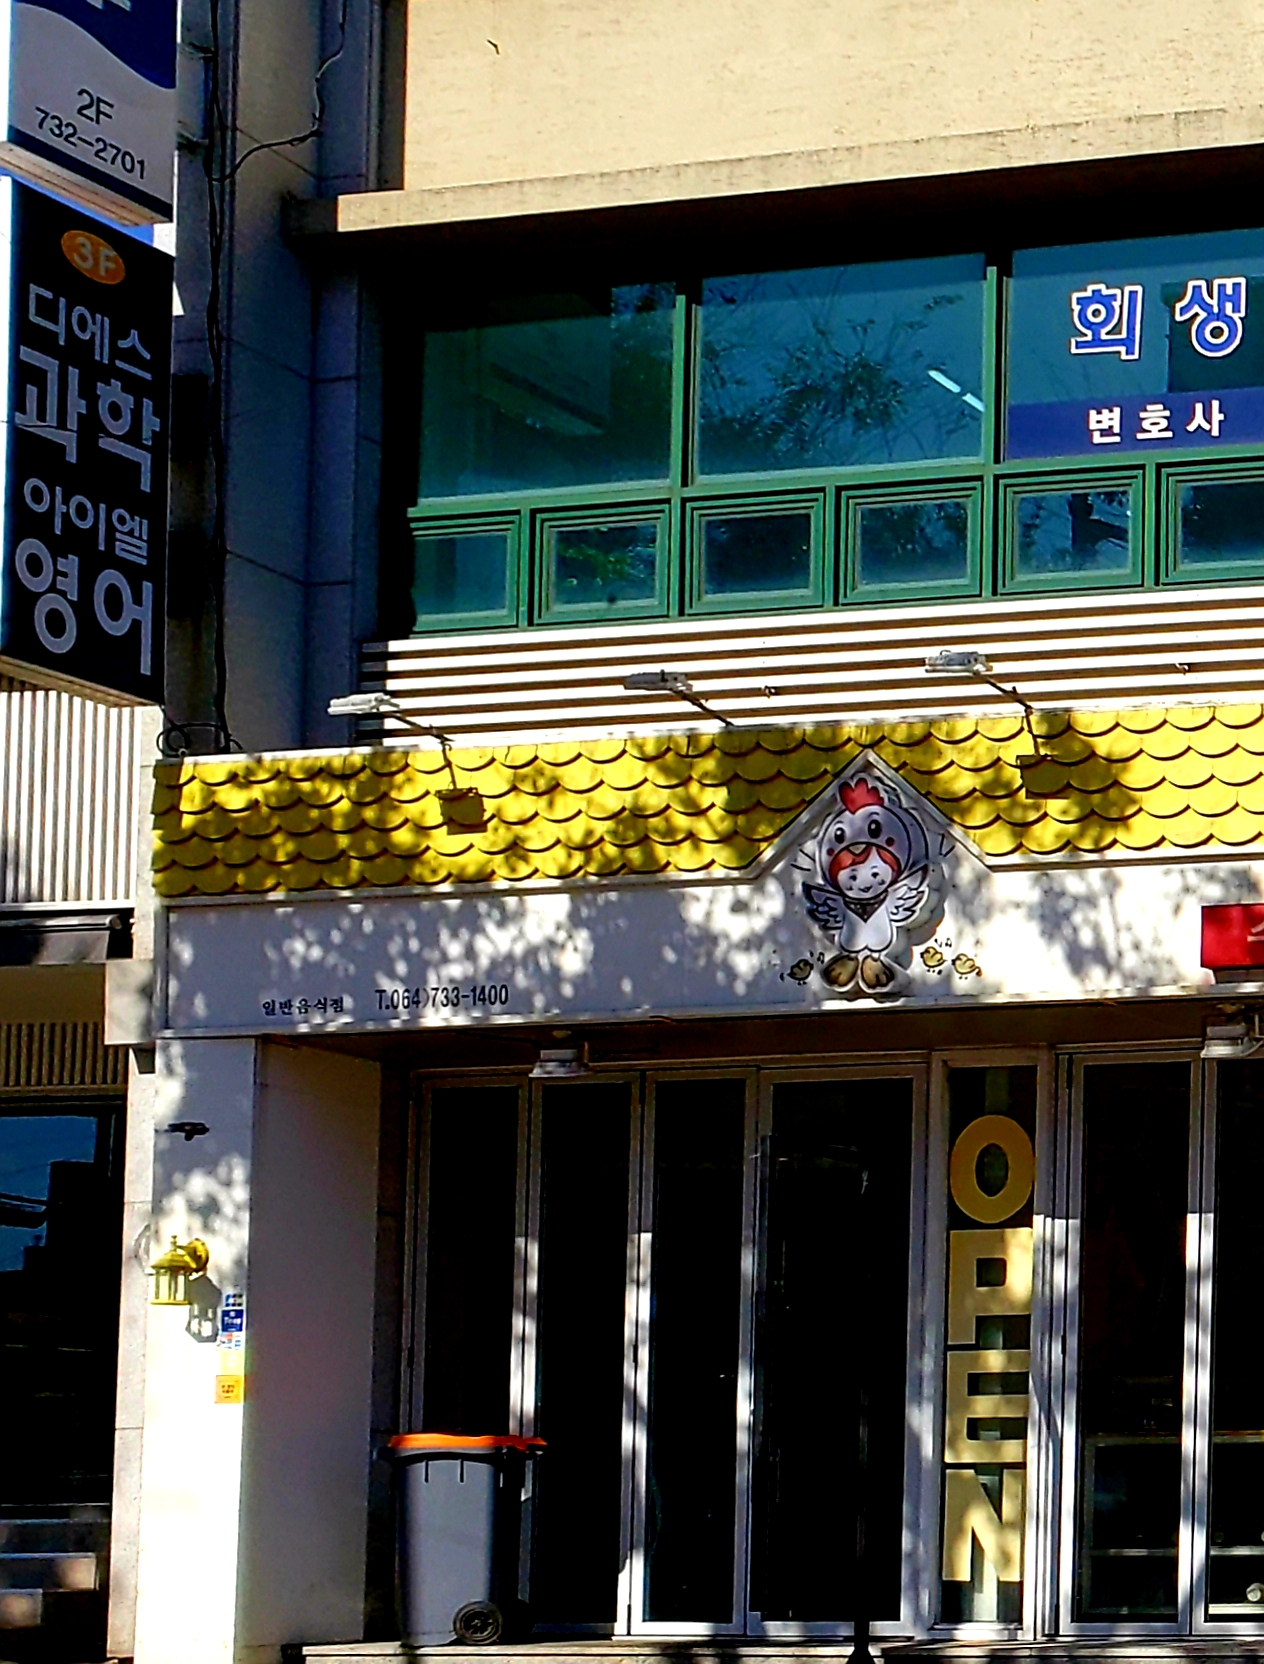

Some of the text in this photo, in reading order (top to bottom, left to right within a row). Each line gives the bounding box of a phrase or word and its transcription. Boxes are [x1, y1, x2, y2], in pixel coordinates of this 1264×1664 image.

[35, 106, 145, 179] 732-2701
[77, 88, 114, 124] 2F
[73, 236, 117, 277] 3F
[29, 283, 152, 380] 디에스
[1070, 277, 1248, 359] 회생
[15, 346, 160, 492] 과학
[1089, 399, 1224, 443] 변호사
[24, 478, 148, 566] 아이엘
[15, 538, 152, 675] 영어
[262, 984, 509, 1016] 일반음식점 T.064)733-1400
[942, 1114, 1036, 1581] OPEN
